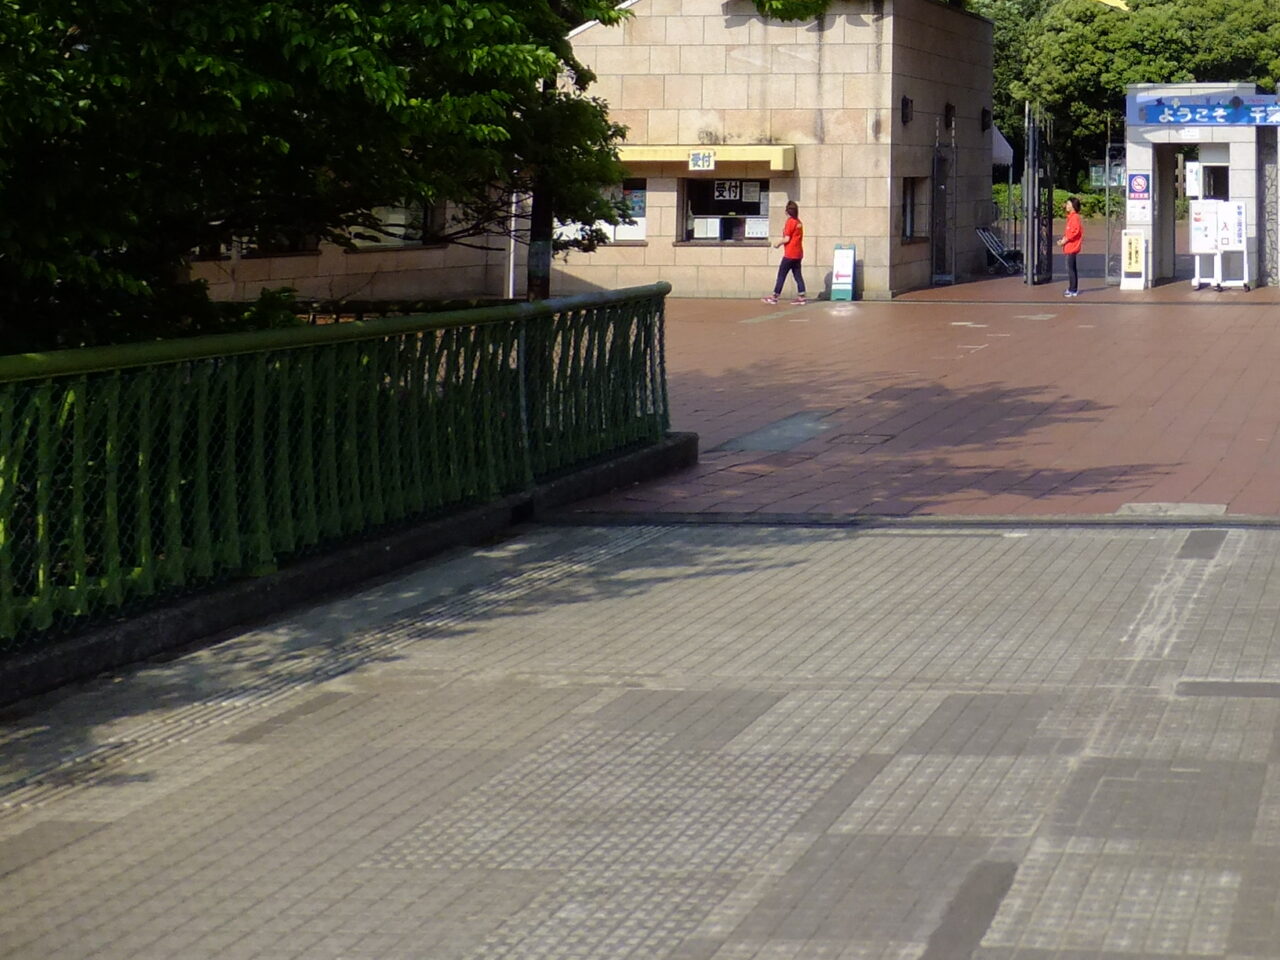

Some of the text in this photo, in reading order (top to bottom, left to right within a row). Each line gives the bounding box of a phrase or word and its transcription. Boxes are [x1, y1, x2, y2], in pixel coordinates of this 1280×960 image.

[1158, 107, 1227, 123] ようこそ
[691, 152, 712, 168] 受付
[715, 181, 740, 199] 受付
